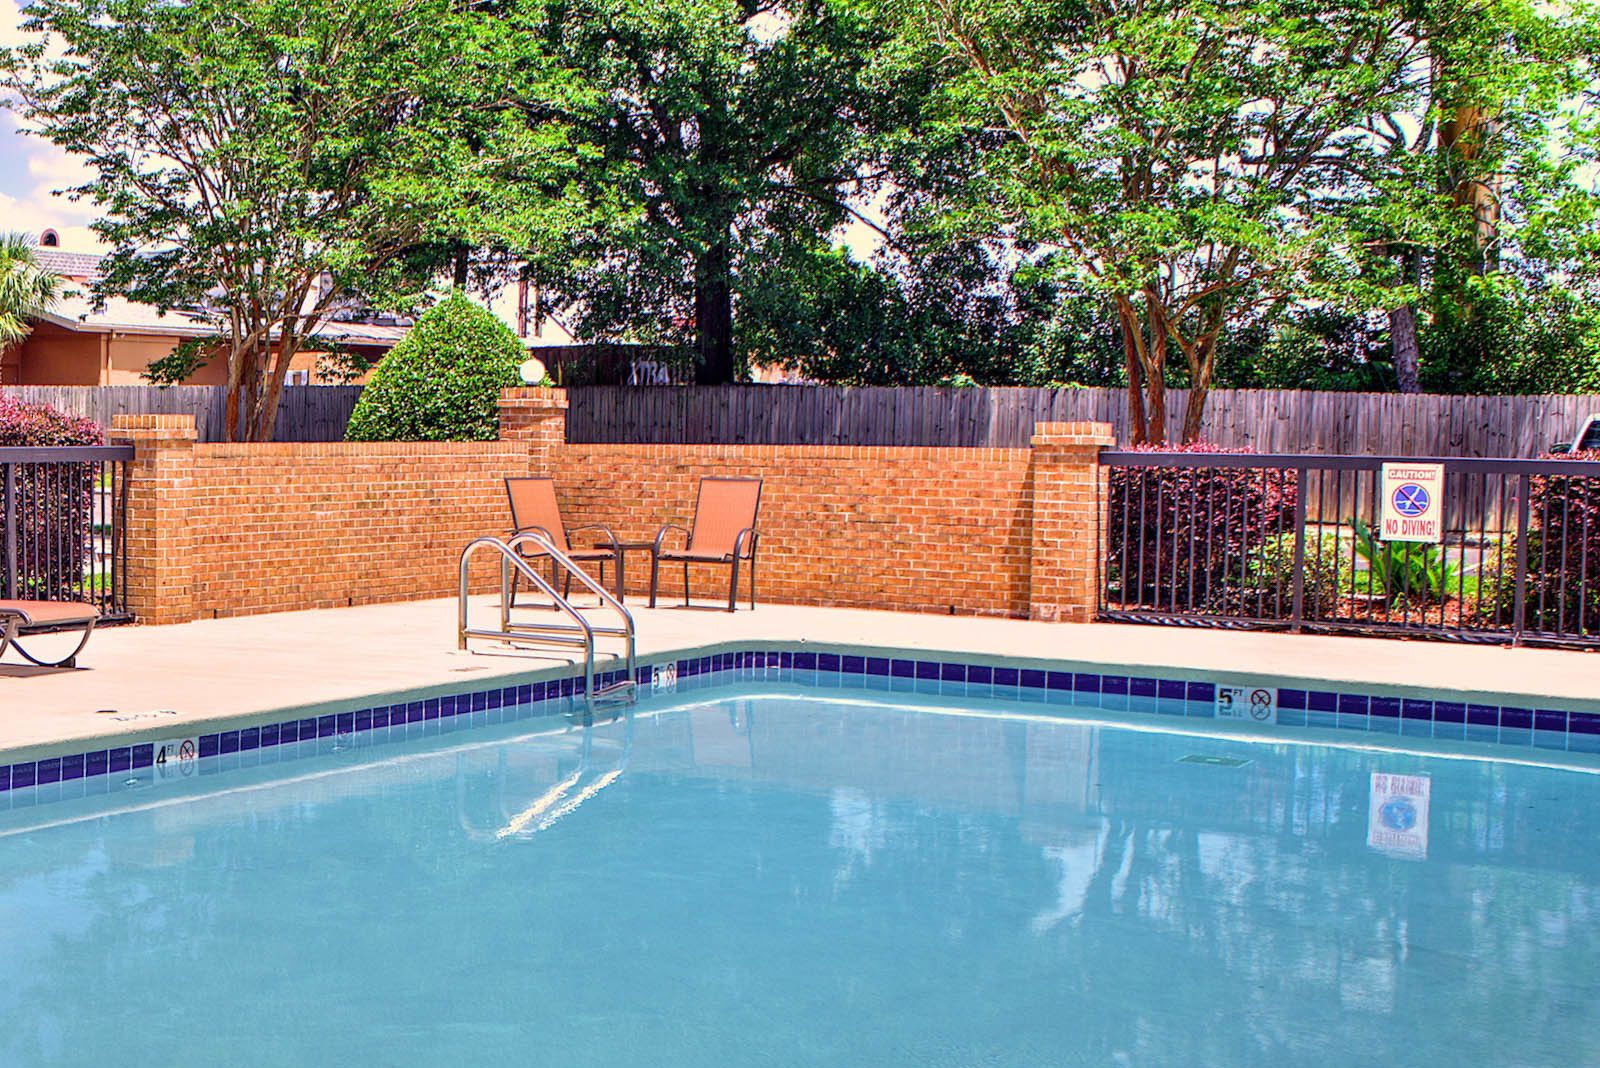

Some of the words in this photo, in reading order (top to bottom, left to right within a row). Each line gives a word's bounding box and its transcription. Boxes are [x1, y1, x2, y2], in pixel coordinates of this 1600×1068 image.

[1388, 470, 1436, 480] CAUTION!
[1385, 519, 1398, 535] NO
[1401, 519, 1436, 537] DIVING!
[1218, 687, 1233, 704] 5
[155, 745, 168, 765] 4
